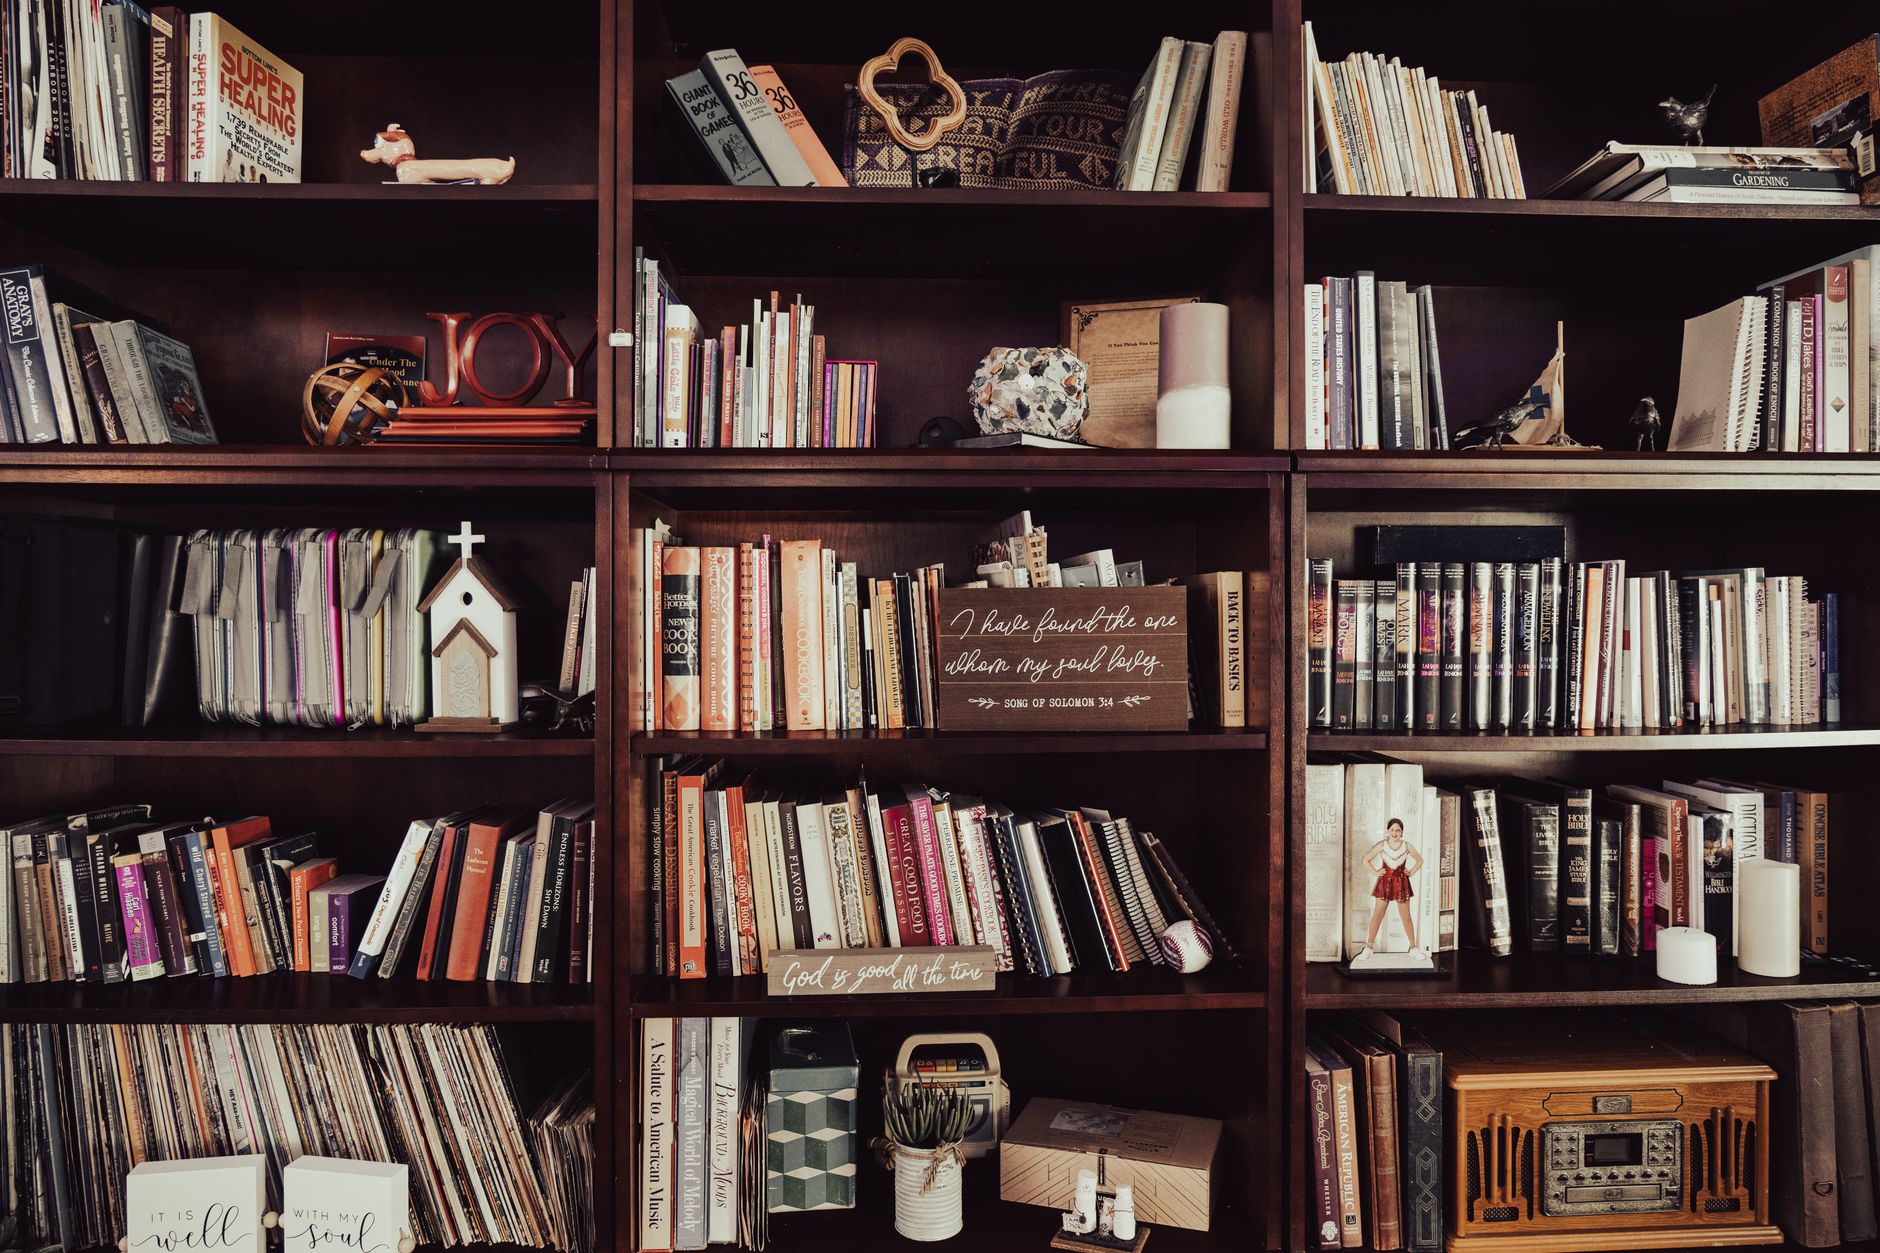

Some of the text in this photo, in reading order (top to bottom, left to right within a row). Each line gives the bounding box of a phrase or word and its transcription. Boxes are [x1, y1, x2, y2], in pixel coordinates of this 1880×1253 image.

[152, 37, 166, 94] HEALTH
[241, 46, 263, 66] BOTTOM
[48, 42, 60, 138] YEARBOOK 2002
[221, 40, 296, 114] SUPER
[682, 84, 711, 104] GIANT
[726, 71, 758, 100] 36
[196, 54, 206, 159] SUPER HEALING
[220, 71, 296, 138] HEALING
[691, 98, 720, 116] BOOK
[707, 110, 716, 120] OF
[739, 96, 766, 110] HOURS
[765, 86, 796, 114] 36
[778, 109, 802, 123] HOURS
[152, 98, 166, 162] SECRETS
[248, 125, 289, 156] REMARKABLE
[700, 114, 735, 137] GAMES
[1220, 120, 1228, 151] WORLD
[230, 141, 256, 164] HEALTH
[1733, 173, 1789, 187] GARDENING
[3, 278, 23, 337] ANATOMY
[17, 285, 33, 326] GRAY'S
[416, 312, 597, 406] JOY
[1335, 308, 1343, 386] UNITED STATES HISTORY
[1802, 318, 1812, 368] T.D. Jakes
[398, 358, 417, 368] The
[1805, 394, 1813, 421] Leading
[663, 630, 697, 640] COOK
[668, 618, 687, 626] NEW
[950, 605, 1178, 643] I have found the one
[1398, 598, 1411, 644] MARK
[663, 643, 697, 654] BOOK
[1228, 591, 1240, 691] BACK TO BASICS
[945, 645, 1164, 682] whom my soul loves.
[1004, 697, 1114, 708] SONG OF SOLOMON 3:4
[1306, 806, 1337, 824] HOLY
[1568, 814, 1590, 823] HOLY
[1568, 822, 1590, 830] BIBLE
[1674, 807, 1682, 831] Exploring
[474, 847, 484, 855] The
[651, 807, 661, 891] simply slow cooking
[664, 778, 678, 911] ELEGANT DESSERTS
[1306, 825, 1337, 845] BIBLE
[1675, 842, 1683, 859] NEW
[1814, 804, 1825, 897] CONCISE BIBLE ATLAS
[466, 866, 485, 874] Hymnal
[467, 856, 489, 865] Lutheran
[552, 832, 569, 912] ENDLESS HORIZONS:
[785, 813, 804, 913] NORDSTROM FLAVORS
[899, 818, 924, 934] GREAT GOOD FOOD
[919, 804, 943, 914] THE SILVER PALATE GOOD TIMES
[943, 823, 962, 907] PERRICONE PROMISE
[95, 845, 113, 943] RICHARD WRIGHT NATIVE
[191, 846, 212, 918] wild Cheryl Strayed
[295, 876, 303, 906] Webster's
[687, 868, 695, 897] Cookie
[708, 820, 726, 952] market vegetarian Ross Dobson
[887, 831, 907, 925] JULEE ROSSO
[1676, 862, 1684, 908] TESTAMENT
[123, 892, 135, 917] Hiaasen
[131, 897, 141, 911] Carl
[383, 835, 440, 968] Singing in Harmony GINN
[541, 889, 552, 928] SHY DAWN
[737, 875, 750, 930] COOKY BOOK
[296, 920, 304, 937] Pocket
[313, 915, 321, 932] long
[331, 917, 339, 946] comfort
[297, 938, 305, 965] Dictionary
[783, 954, 983, 995] God is good all the time
[649, 1038, 666, 1230] A Salute to American Music
[715, 1082, 736, 1208] BACKGROUND MOODS
[1337, 1083, 1355, 1210] AMERICAN REPUBLIC
[679, 1076, 703, 1232] Magical World of Melody
[293, 1208, 359, 1223] WITH MY
[1323, 1178, 1331, 1216] WHEELER
[131, 1202, 254, 1248] well
[151, 1210, 194, 1223] IT IS
[286, 1212, 390, 1253] soul
